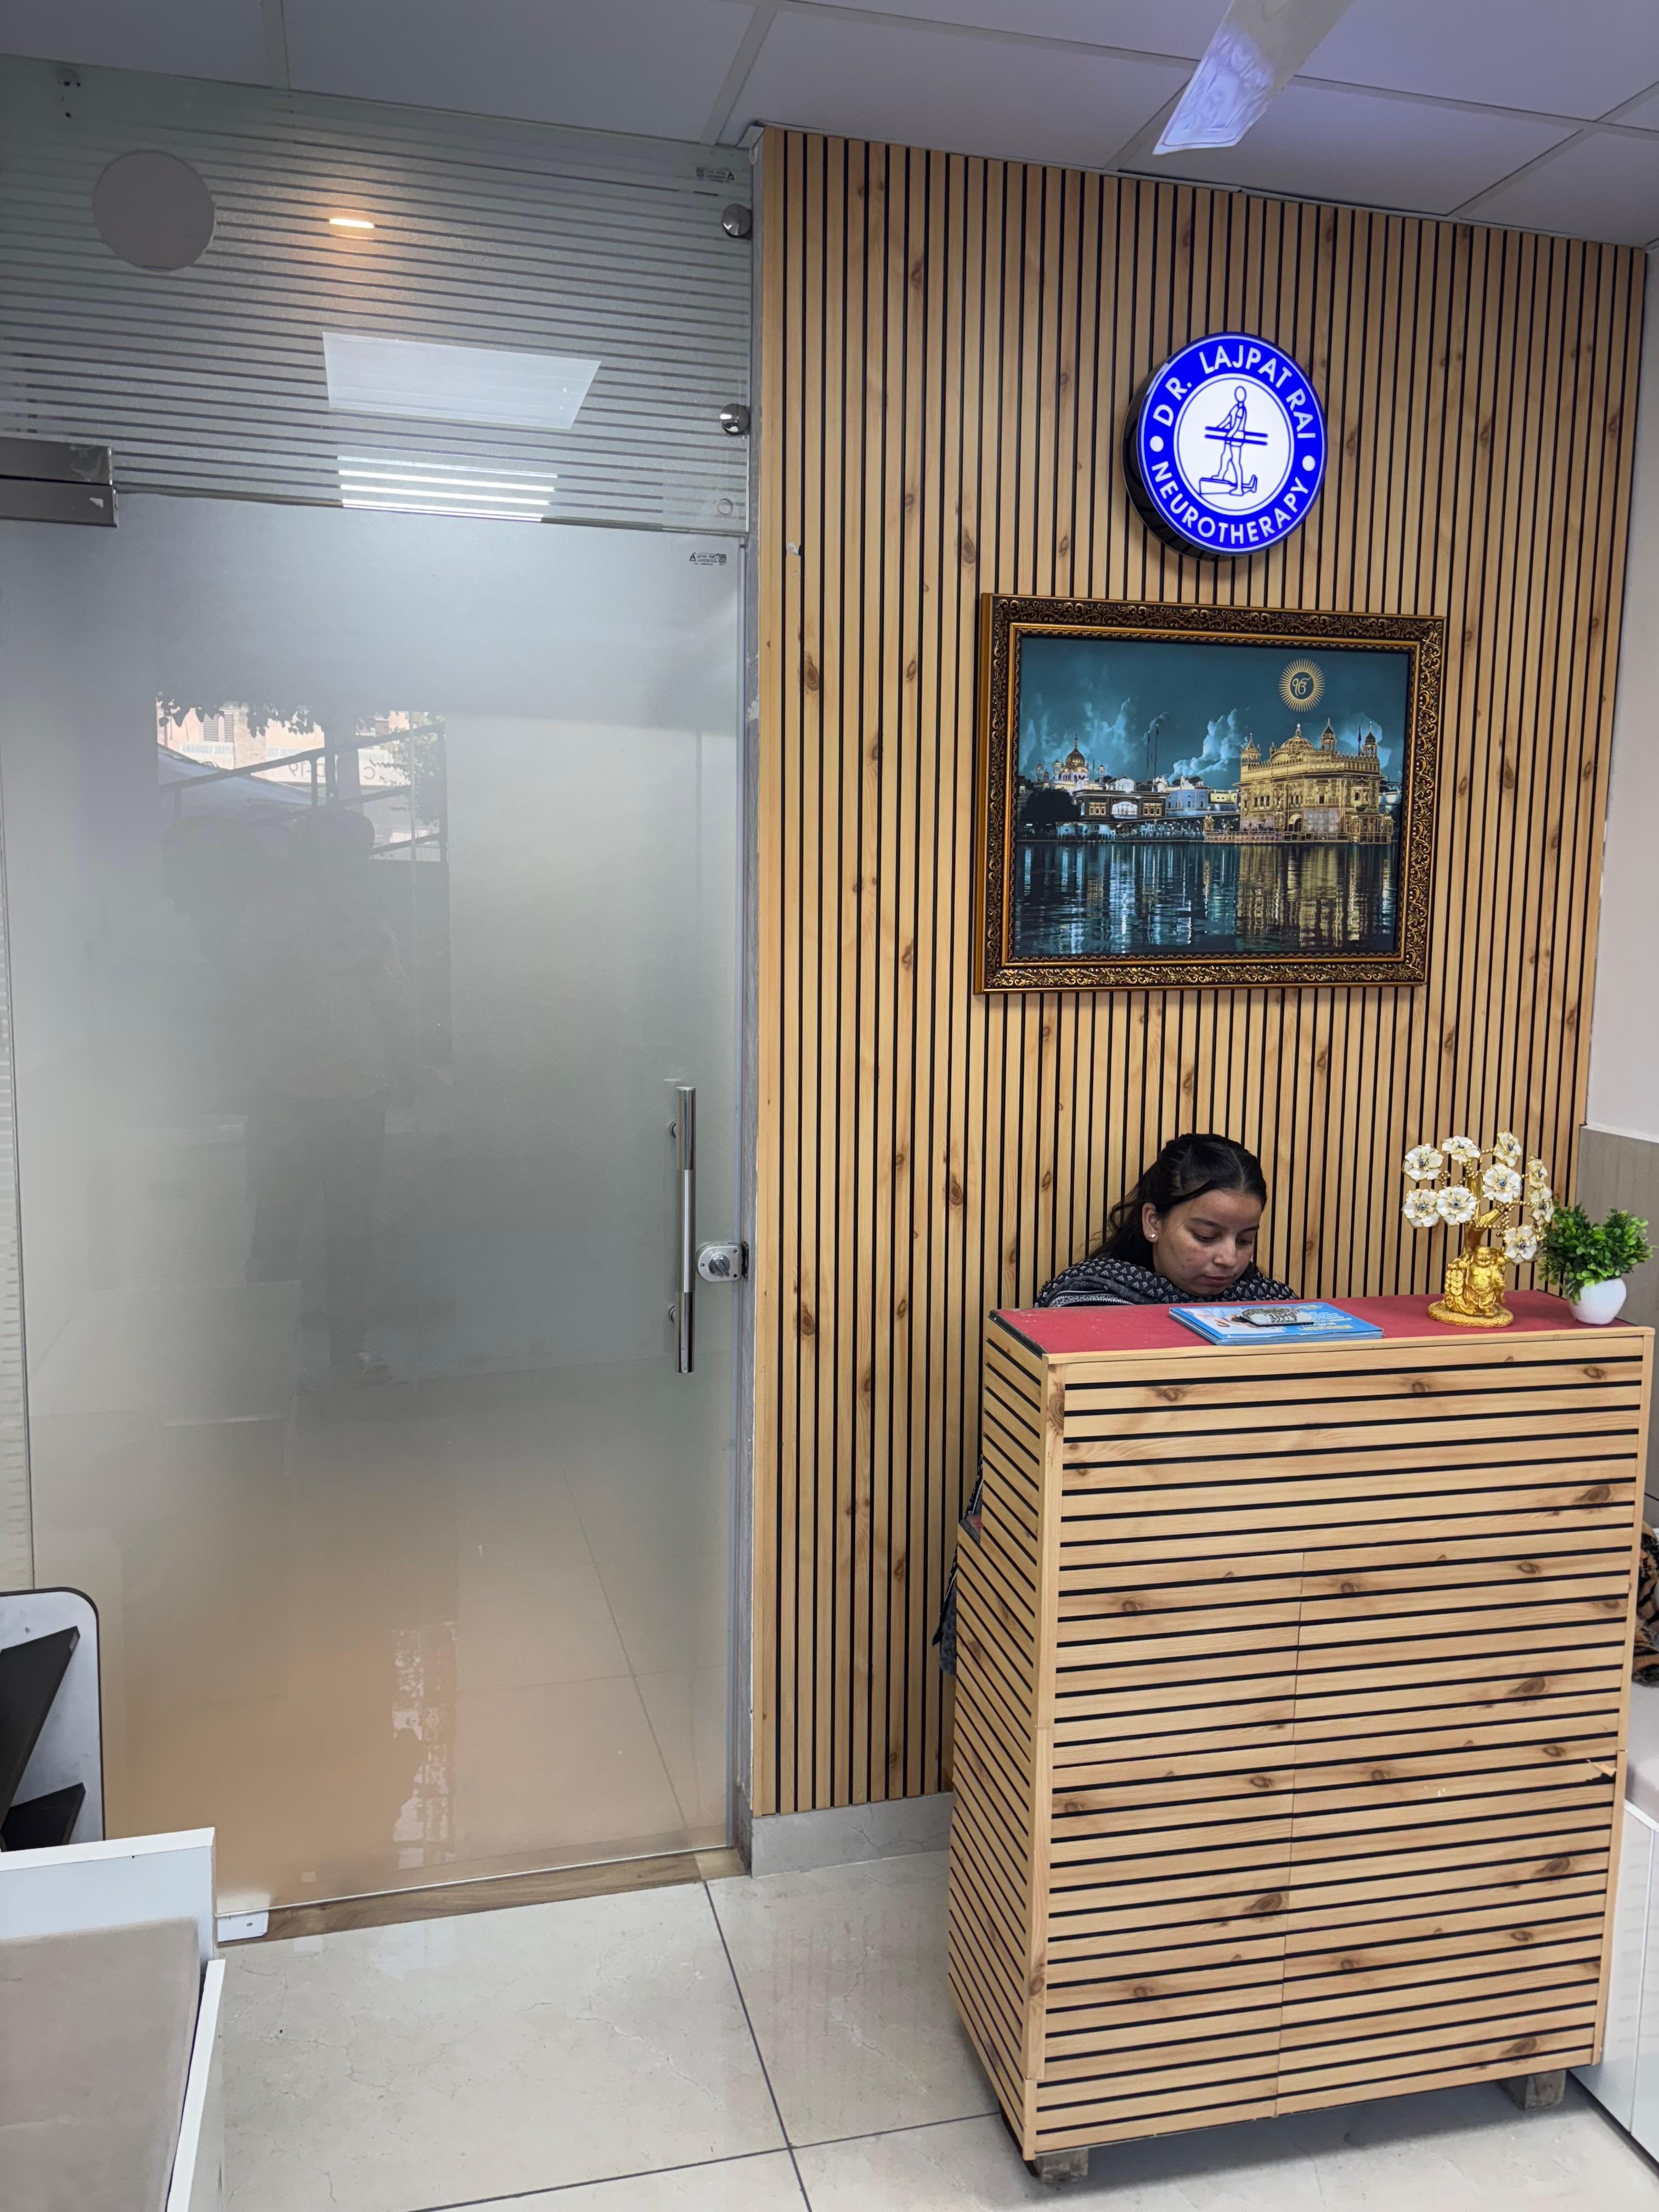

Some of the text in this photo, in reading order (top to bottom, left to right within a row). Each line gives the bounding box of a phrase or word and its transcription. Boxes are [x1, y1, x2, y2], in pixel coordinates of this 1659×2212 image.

[1153, 345, 1316, 439] DR. LAJPAT RAI
[1152, 461, 1309, 544] NEUROTHERAPY
